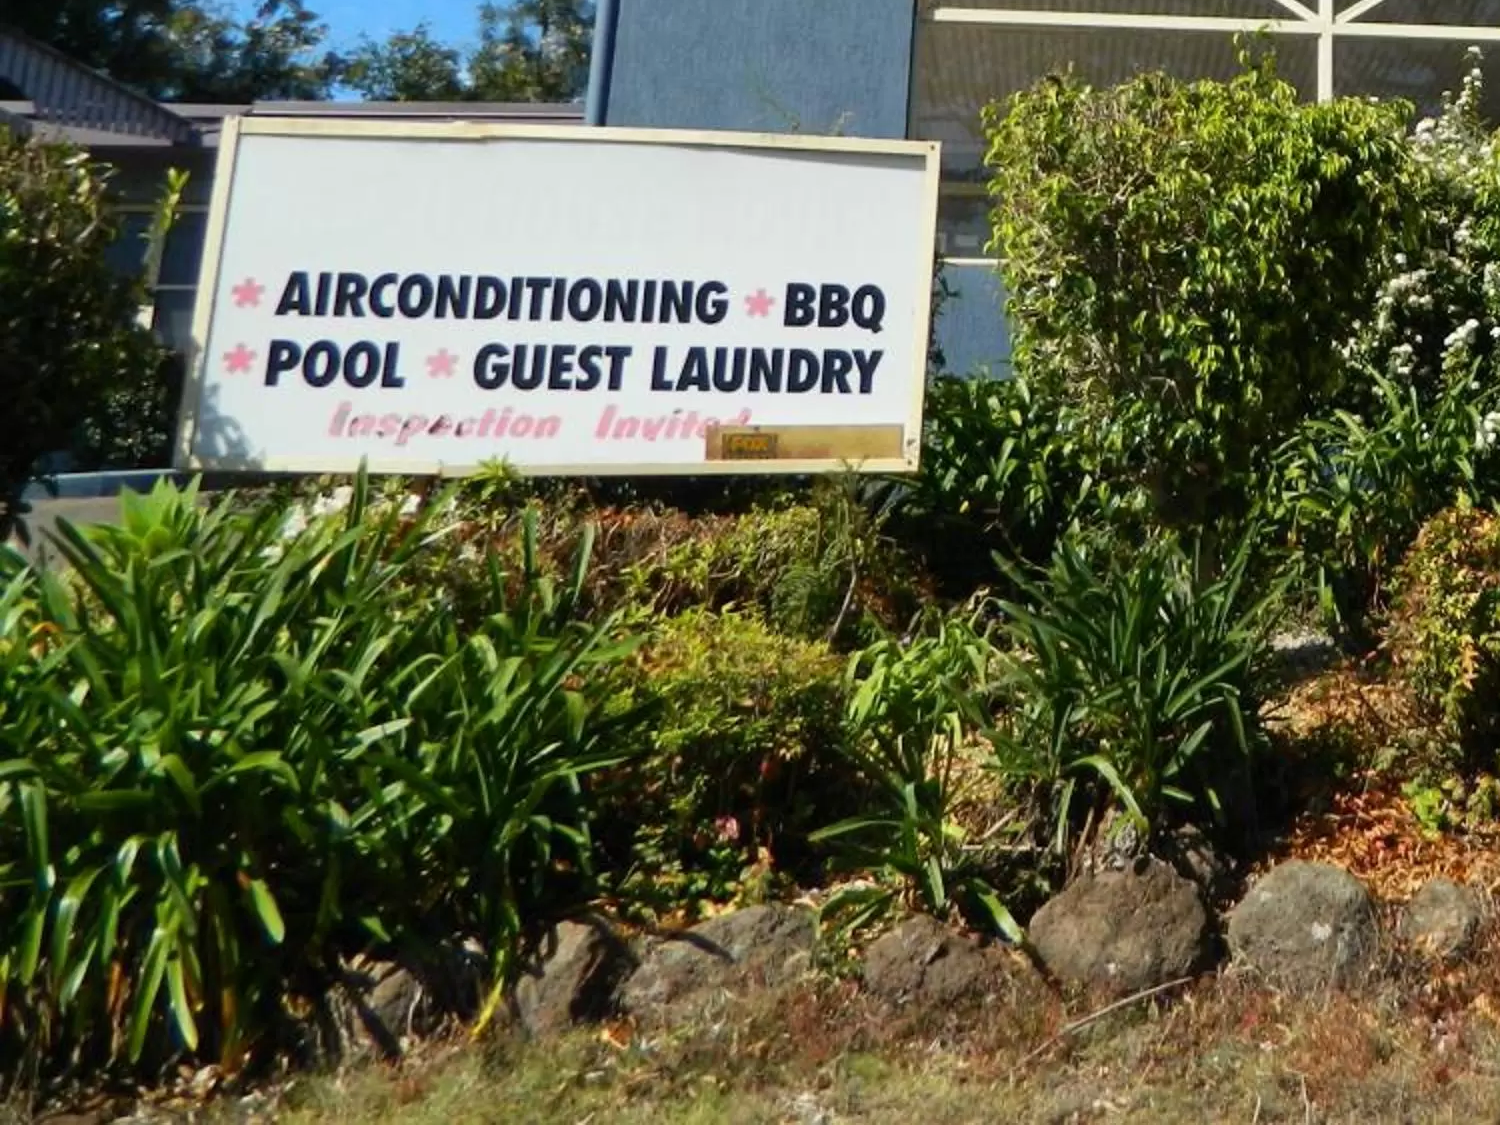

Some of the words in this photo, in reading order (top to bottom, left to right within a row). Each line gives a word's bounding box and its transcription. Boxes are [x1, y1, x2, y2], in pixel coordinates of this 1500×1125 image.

[275, 271, 729, 325] AIRCONDITIONING
[783, 282, 886, 334] BBQ
[264, 340, 405, 388] POOL
[473, 344, 632, 392] GUEST
[650, 347, 884, 395] LAUNDRY
[328, 401, 562, 446] Inspection
